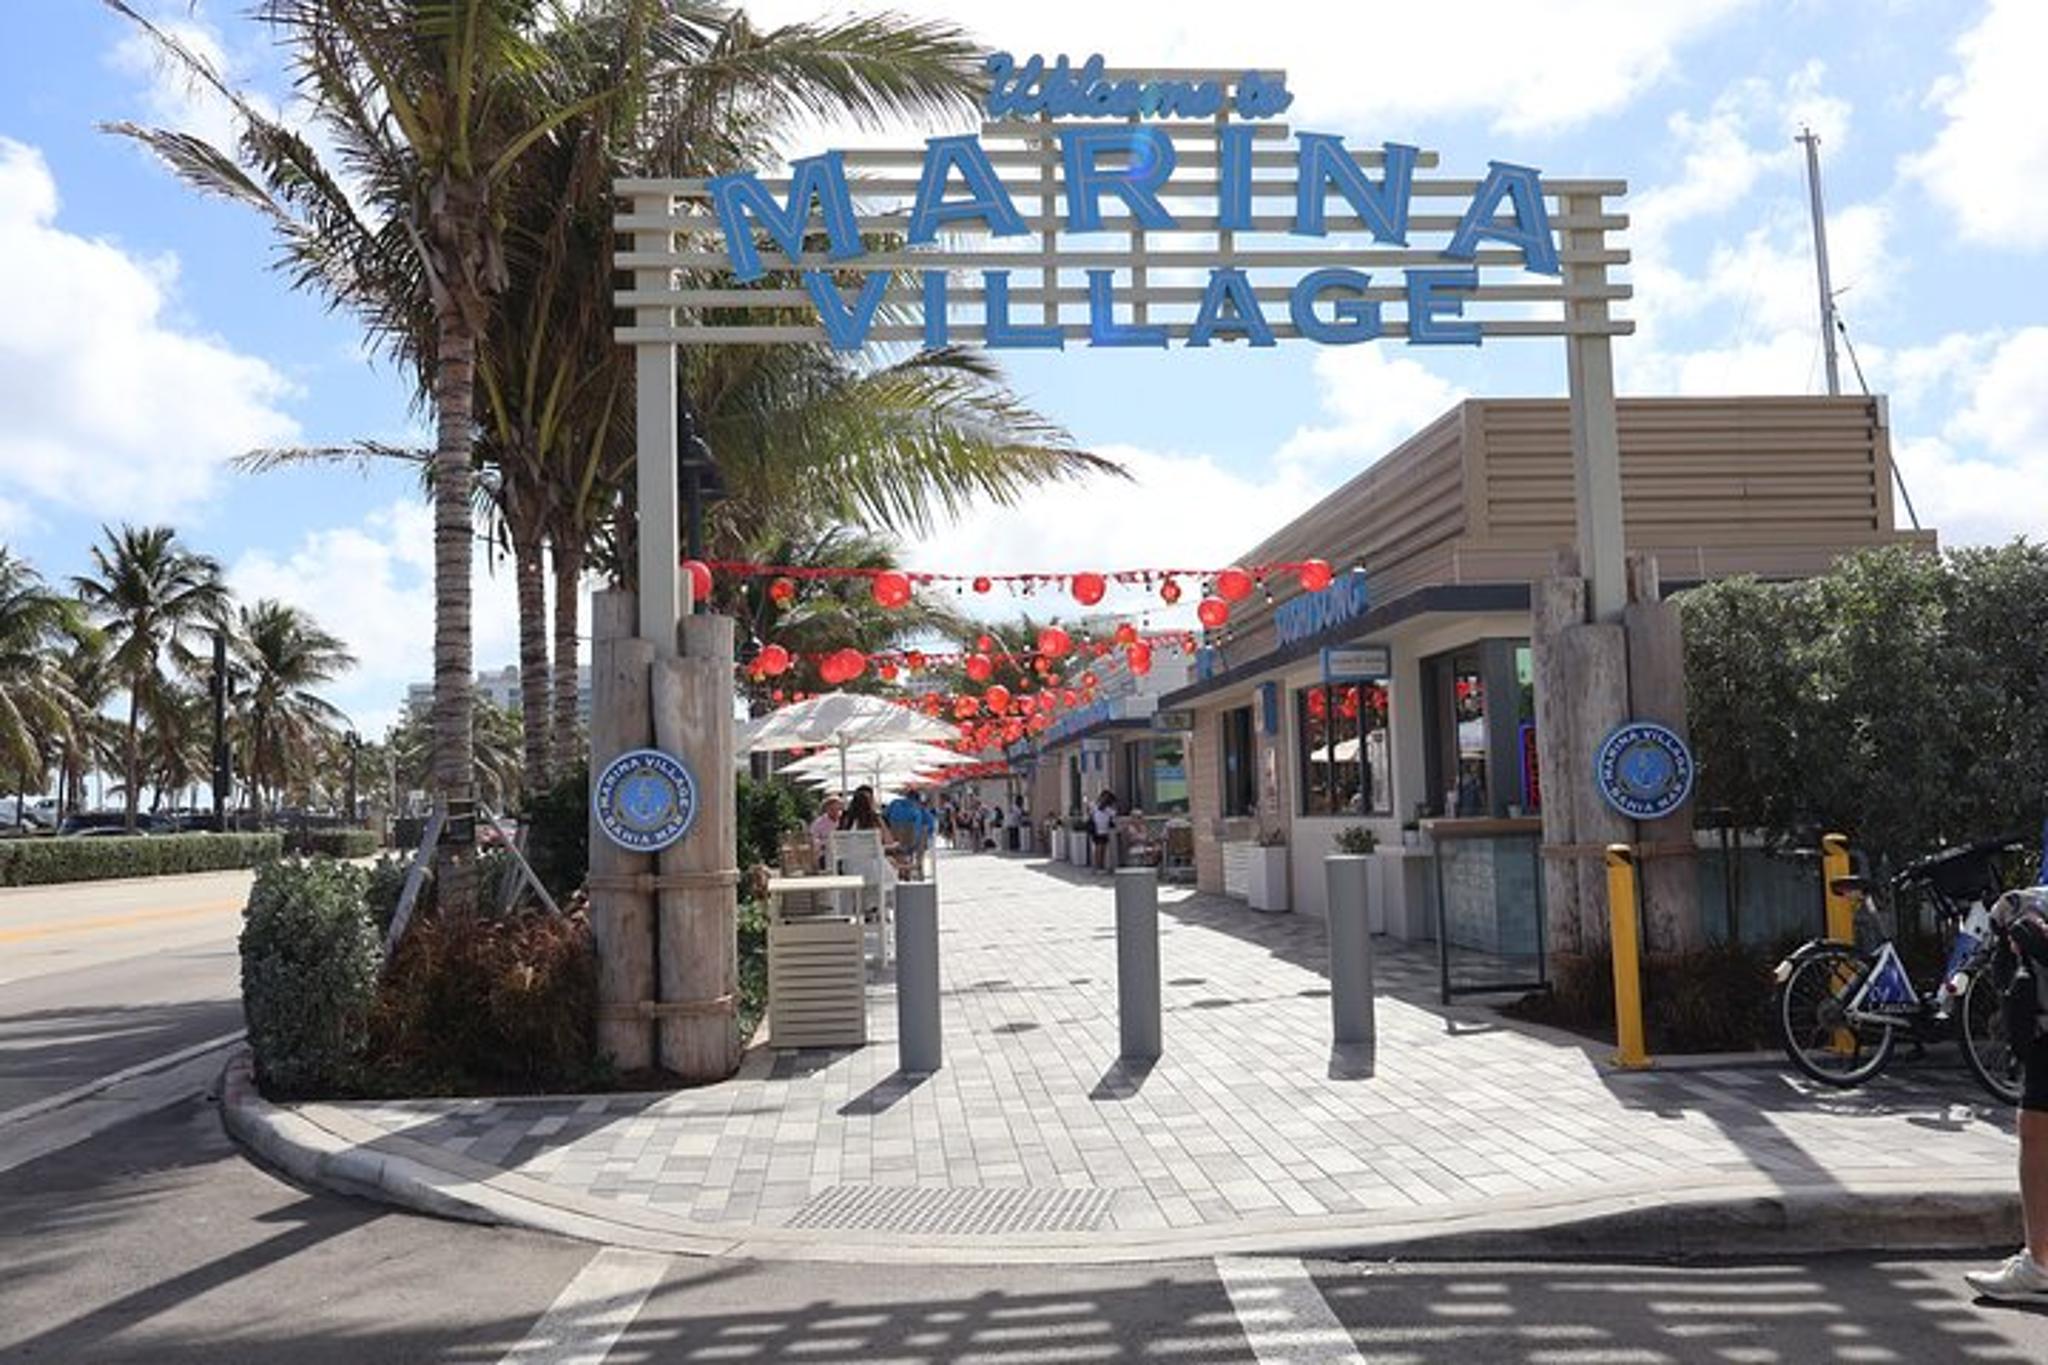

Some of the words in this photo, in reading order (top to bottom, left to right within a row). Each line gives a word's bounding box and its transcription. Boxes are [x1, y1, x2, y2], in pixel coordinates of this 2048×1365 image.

[986, 51, 1221, 120] Welcome
[1237, 70, 1295, 119] to
[707, 123, 1561, 282] MARINA
[801, 265, 1483, 349] VILLAGE
[600, 758, 641, 809] MARINA
[645, 756, 690, 808] VILLAGE
[1603, 732, 1638, 780] MARINA
[1643, 730, 1687, 776] VILLAGE
